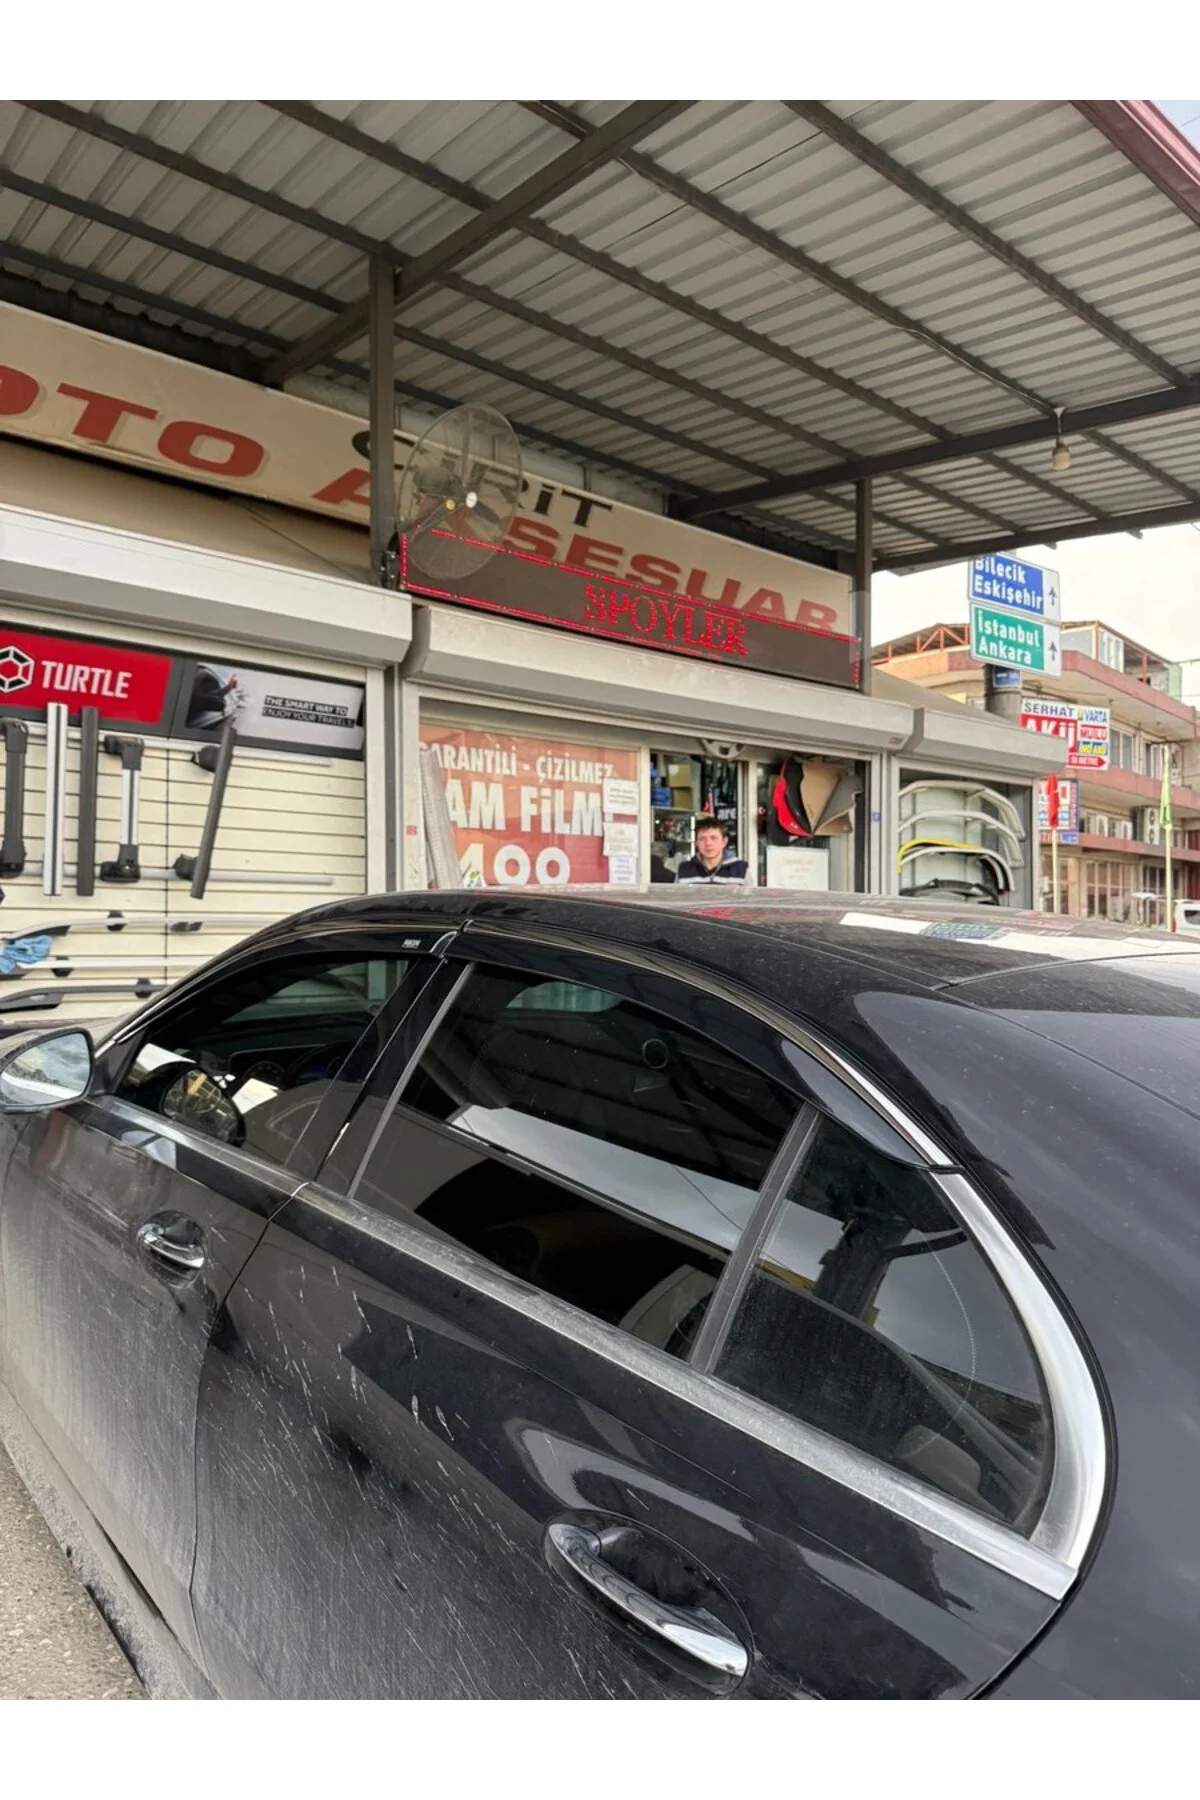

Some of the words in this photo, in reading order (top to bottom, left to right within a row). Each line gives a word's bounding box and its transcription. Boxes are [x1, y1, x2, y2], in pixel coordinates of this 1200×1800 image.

[975, 557, 1026, 584] Bilecik
[974, 574, 1042, 609] Eskişehir
[584, 583, 748, 656] SPOYLER
[978, 610, 1040, 647] İstanbul
[979, 635, 1032, 665] Ankara
[41, 660, 132, 699] TURTLE
[263, 708, 290, 718] ENJOY
[293, 711, 317, 721] YOUR
[266, 697, 283, 707] THE
[286, 699, 314, 710] SMART
[316, 704, 334, 713] WAY
[336, 707, 348, 716] TO
[1024, 702, 1075, 717] SERHAT
[536, 750, 613, 785] ÇİZİLMEZ
[446, 778, 506, 831] AM
